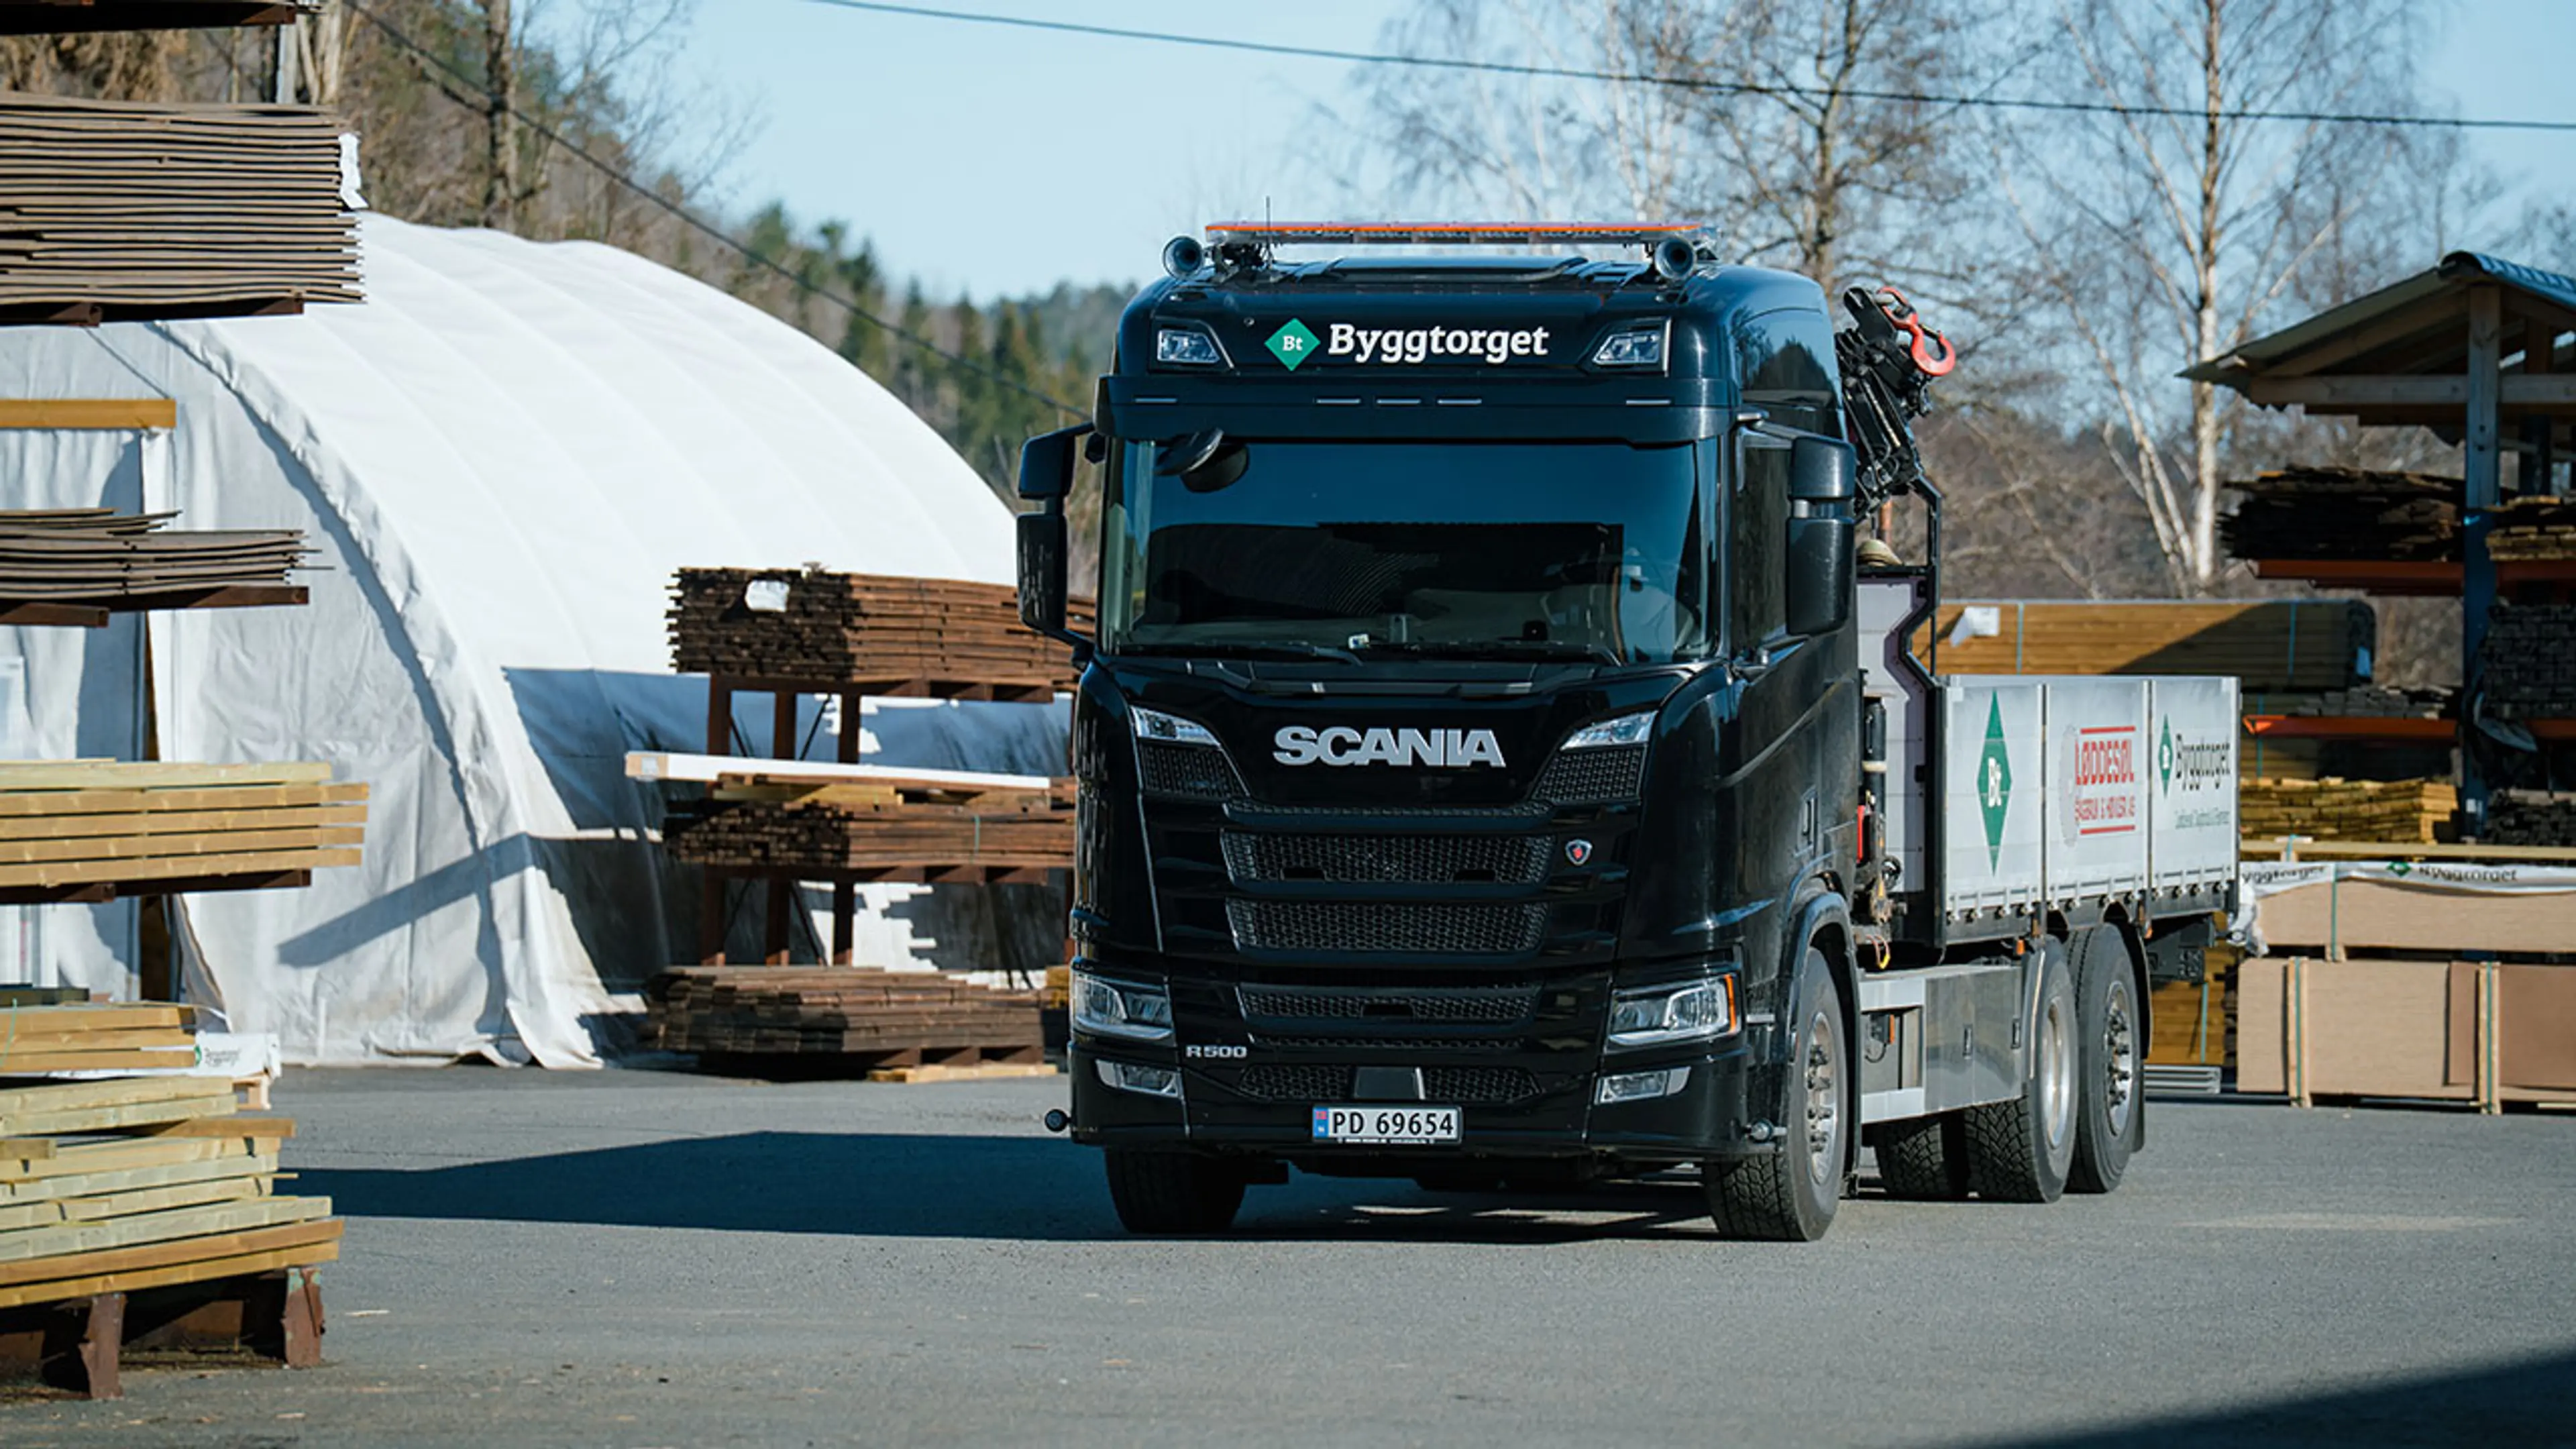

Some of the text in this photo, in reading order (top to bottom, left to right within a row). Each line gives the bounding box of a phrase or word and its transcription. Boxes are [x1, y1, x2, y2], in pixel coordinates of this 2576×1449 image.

[1282, 323, 1549, 364] Bt Byggtorget
[1273, 726, 1506, 768] SCANIA
[2176, 733, 2231, 792] Byggtorget
[1988, 757, 2002, 808] Bt
[1186, 1044, 1247, 1058] R500
[1333, 1112, 1454, 1135] PD 69654
